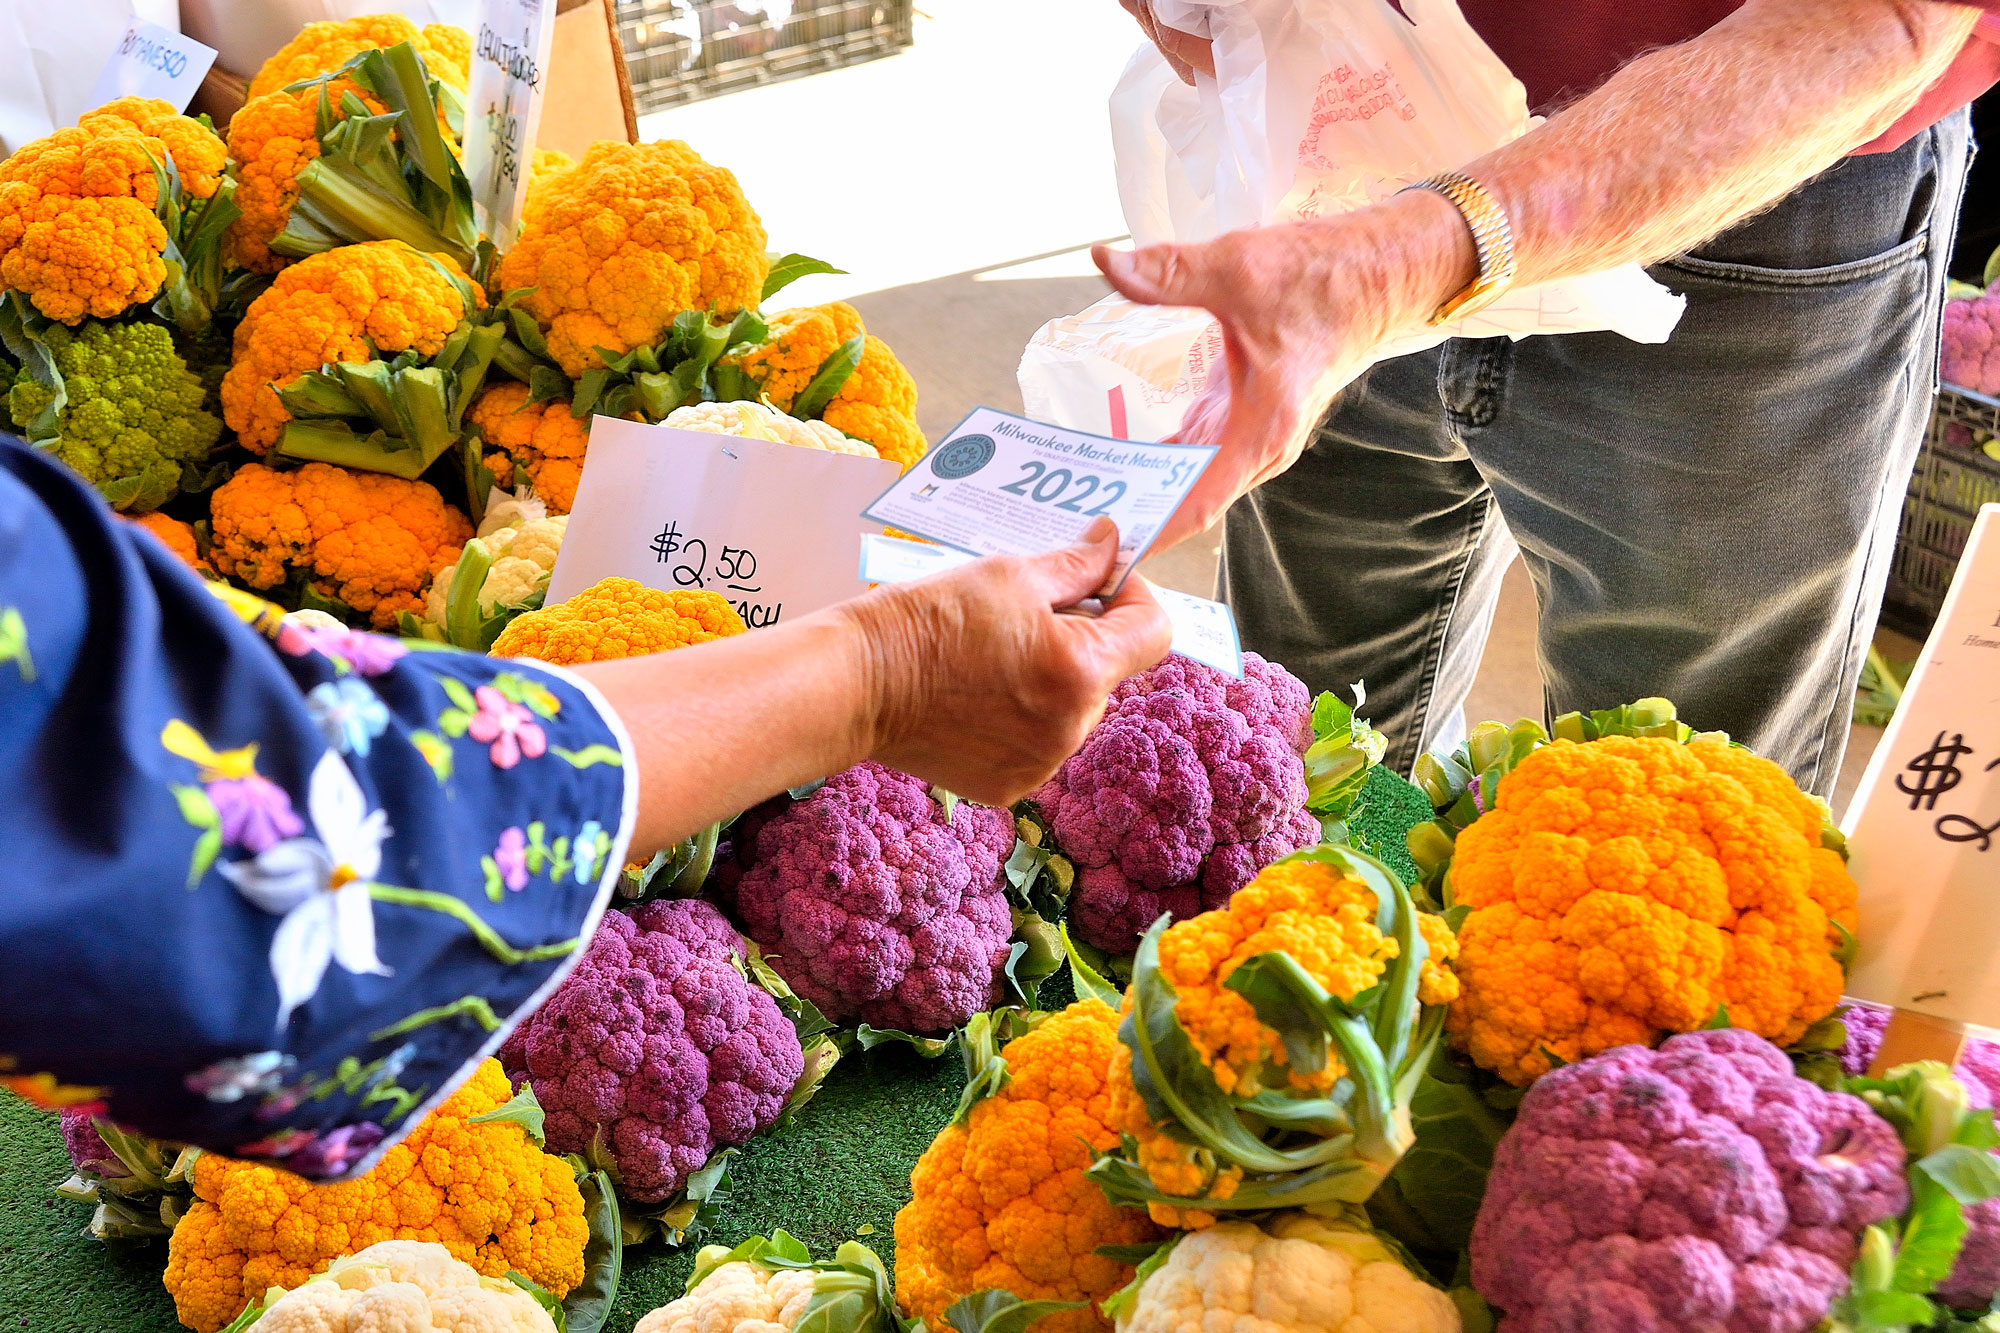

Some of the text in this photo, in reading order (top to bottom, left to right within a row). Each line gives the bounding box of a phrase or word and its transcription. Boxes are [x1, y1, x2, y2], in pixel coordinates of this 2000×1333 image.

[992, 421, 1198, 490] Milwaukee Market Match $1
[998, 460, 1128, 516] 2022
[649, 520, 757, 588] $2.50
[729, 600, 782, 629] ACH
